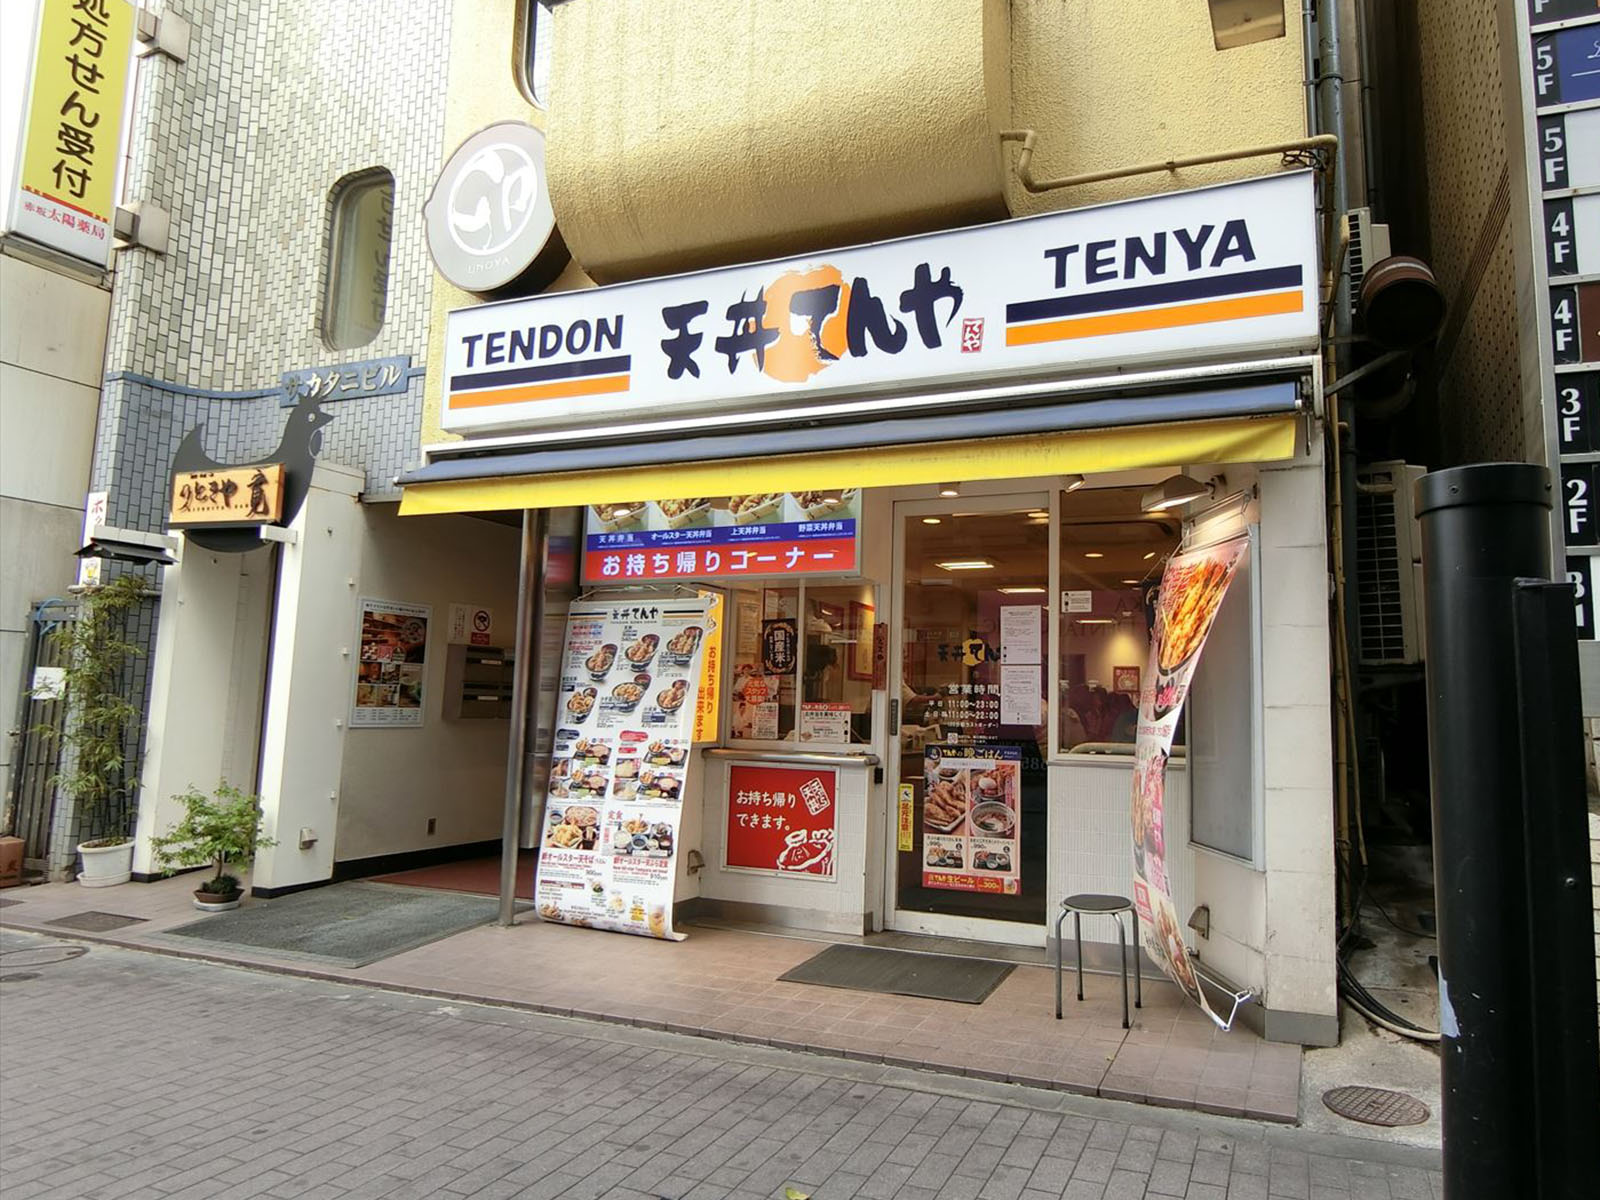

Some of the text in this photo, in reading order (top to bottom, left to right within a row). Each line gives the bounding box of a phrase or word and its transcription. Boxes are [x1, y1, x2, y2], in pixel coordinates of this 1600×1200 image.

[1536, 46, 1553, 95] 5F
[1544, 128, 1564, 183] 5F
[24, 201, 105, 241] 赤坂太陽薬局
[1552, 212, 1570, 263] 4F
[1044, 218, 1256, 289] TENYA
[462, 314, 624, 368] TENDON
[1554, 299, 1572, 351] 4F
[286, 365, 401, 401] サカタニビル
[1561, 388, 1581, 442] 3F
[1566, 479, 1588, 534] 2F
[598, 521, 844, 544] 天丼弁当 オールスター天丼弁当 上天丼弁当 野菜天丼弁当
[602, 546, 834, 577] お持ち帰りコーナー
[948, 683, 1000, 697] 営業時間
[736, 790, 796, 808] お持ち帰り
[736, 813, 790, 831] できます。
